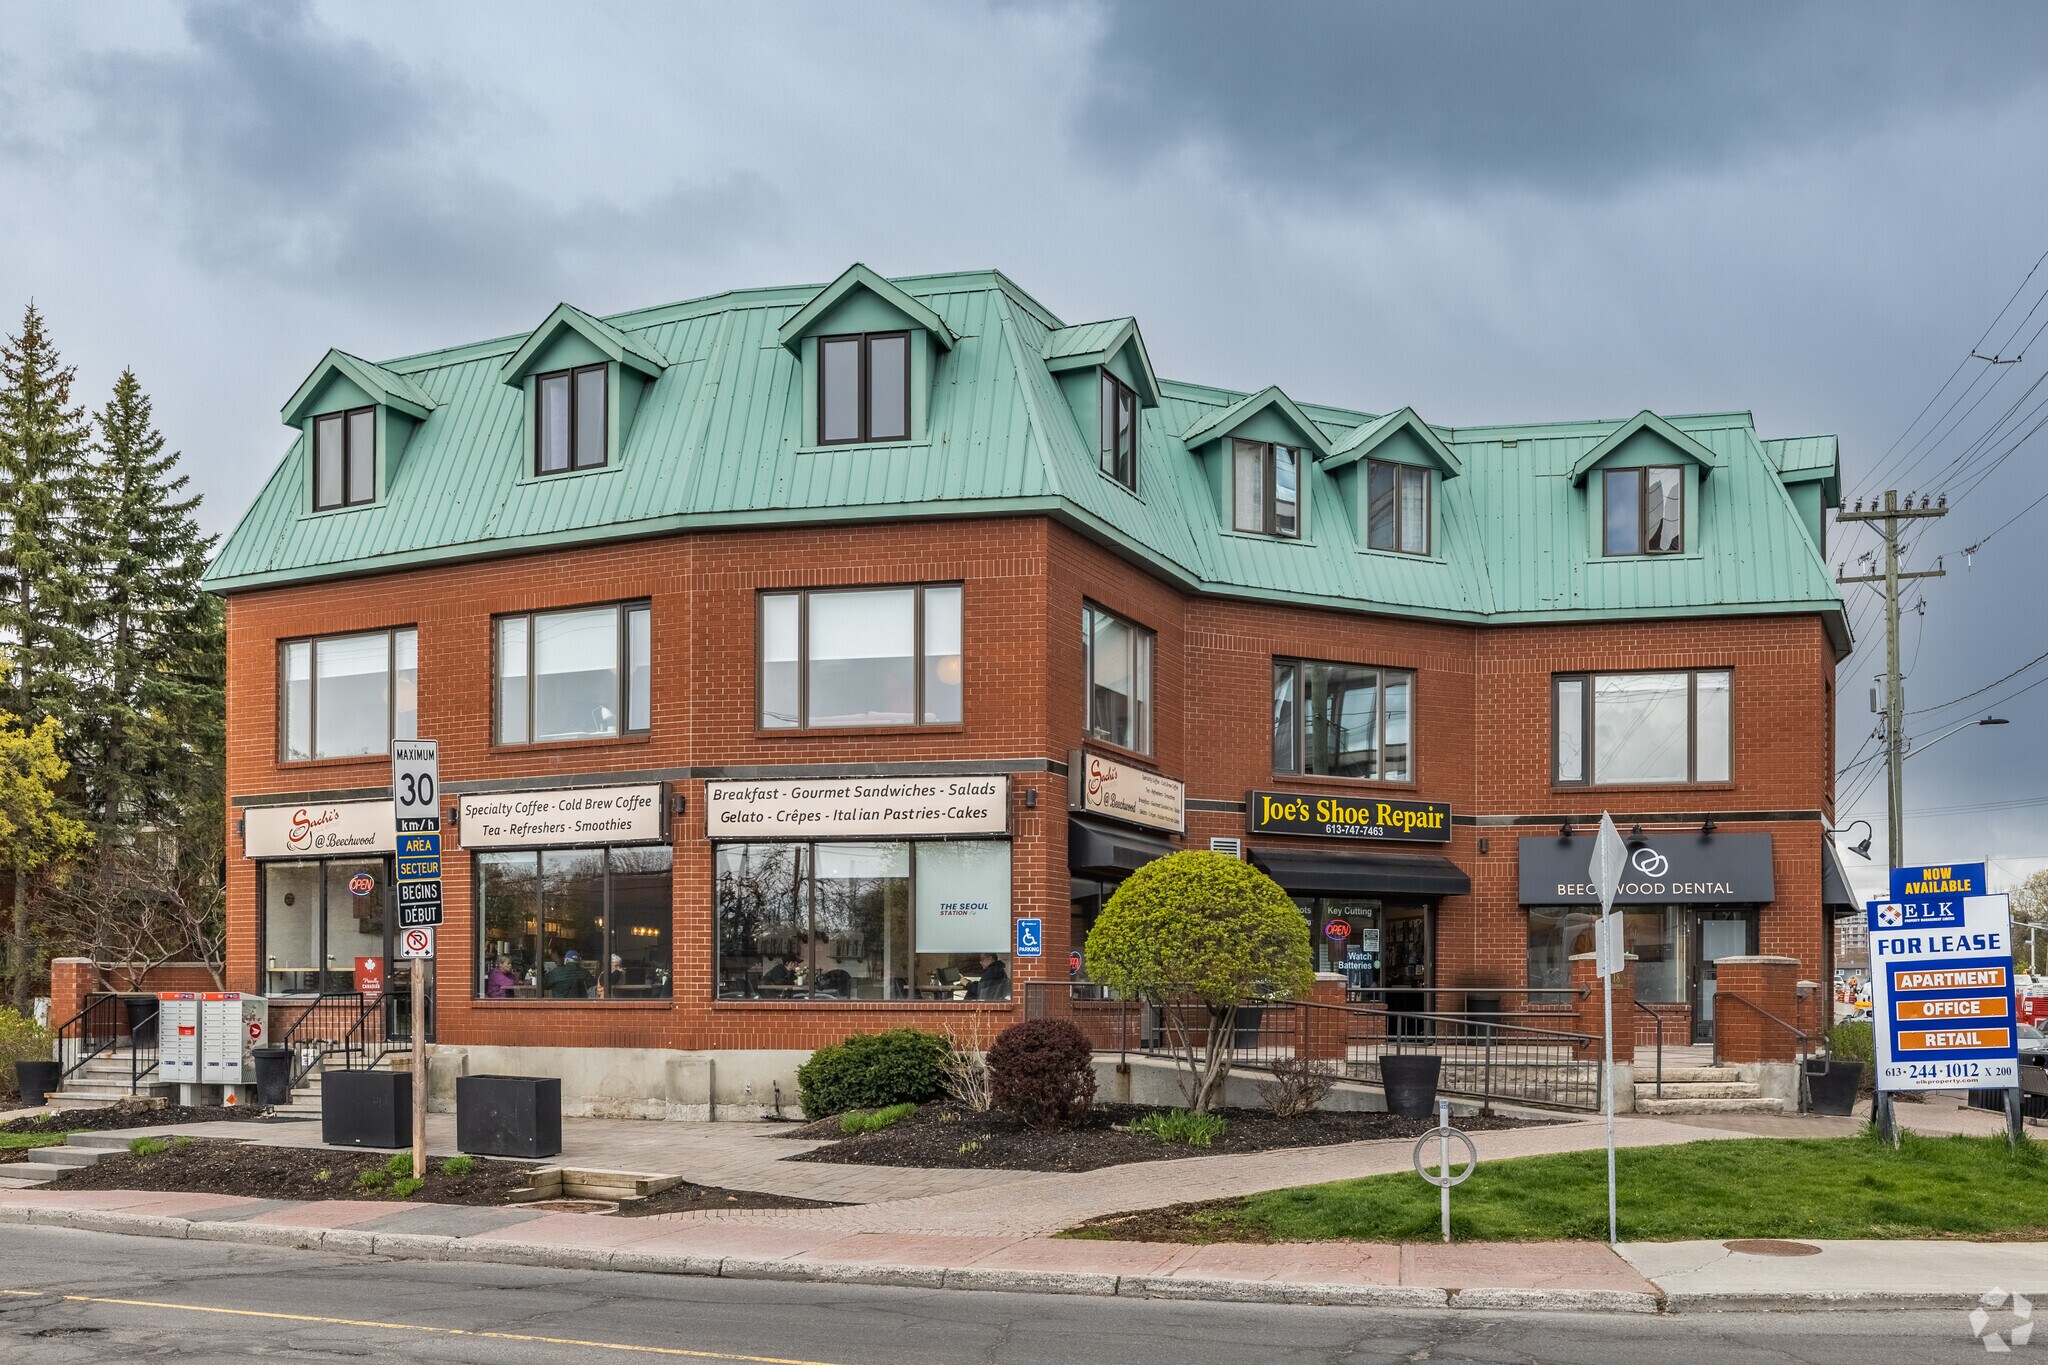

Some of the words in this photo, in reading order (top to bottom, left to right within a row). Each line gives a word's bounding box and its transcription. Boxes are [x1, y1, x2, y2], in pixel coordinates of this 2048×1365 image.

[397, 749, 434, 760] MAXIMUM
[1089, 760, 1118, 794] Sachi's
[400, 773, 434, 806] 30
[713, 787, 779, 803] Breakfast
[792, 787, 850, 799] Gourmet
[854, 784, 936, 798] Sandwiches
[949, 782, 996, 796] Salads
[465, 802, 513, 818] Specialty
[515, 800, 549, 817] Coffee
[558, 798, 582, 811] Cold
[585, 798, 613, 810] Brew
[615, 795, 651, 811] Coffee
[721, 811, 764, 823] Gelato
[776, 809, 821, 825] Crêpes
[834, 808, 880, 821] Italian
[1261, 796, 1310, 825] Joe's
[1316, 800, 1369, 825] Shoe
[1376, 803, 1444, 833] Repair
[289, 809, 340, 842] Sachi's
[402, 819, 434, 831] km/h
[482, 824, 500, 836] Tea
[510, 822, 565, 838] Refreshers
[575, 818, 632, 832] Smoothies
[1326, 824, 1384, 837] 613-747-7463
[406, 840, 432, 852] AREA
[400, 862, 438, 874] SECTEUR
[1923, 867, 1952, 880] NOW
[351, 879, 371, 890] OPEN
[402, 884, 438, 900] BEGINS
[1558, 882, 1666, 896] BEECWOOD
[1672, 882, 1734, 895] DENTAL
[1905, 879, 1972, 895] AVAILABLE
[405, 905, 436, 924] DÉBUT
[1328, 906, 1342, 916] Key
[1344, 906, 1372, 917] Cutting
[1904, 902, 1954, 918] ELK
[1327, 925, 1348, 935] OPEN
[1878, 937, 1922, 955] FOR
[1929, 934, 2000, 952] LEASE
[1348, 952, 1372, 960] Watch
[1338, 961, 1372, 970] Batteries
[1900, 971, 1998, 988] APARTMENT
[1923, 1001, 1980, 1016] OFFICE
[1926, 1032, 1982, 1047] RETAIL
[1996, 1067, 2012, 1076] 200
